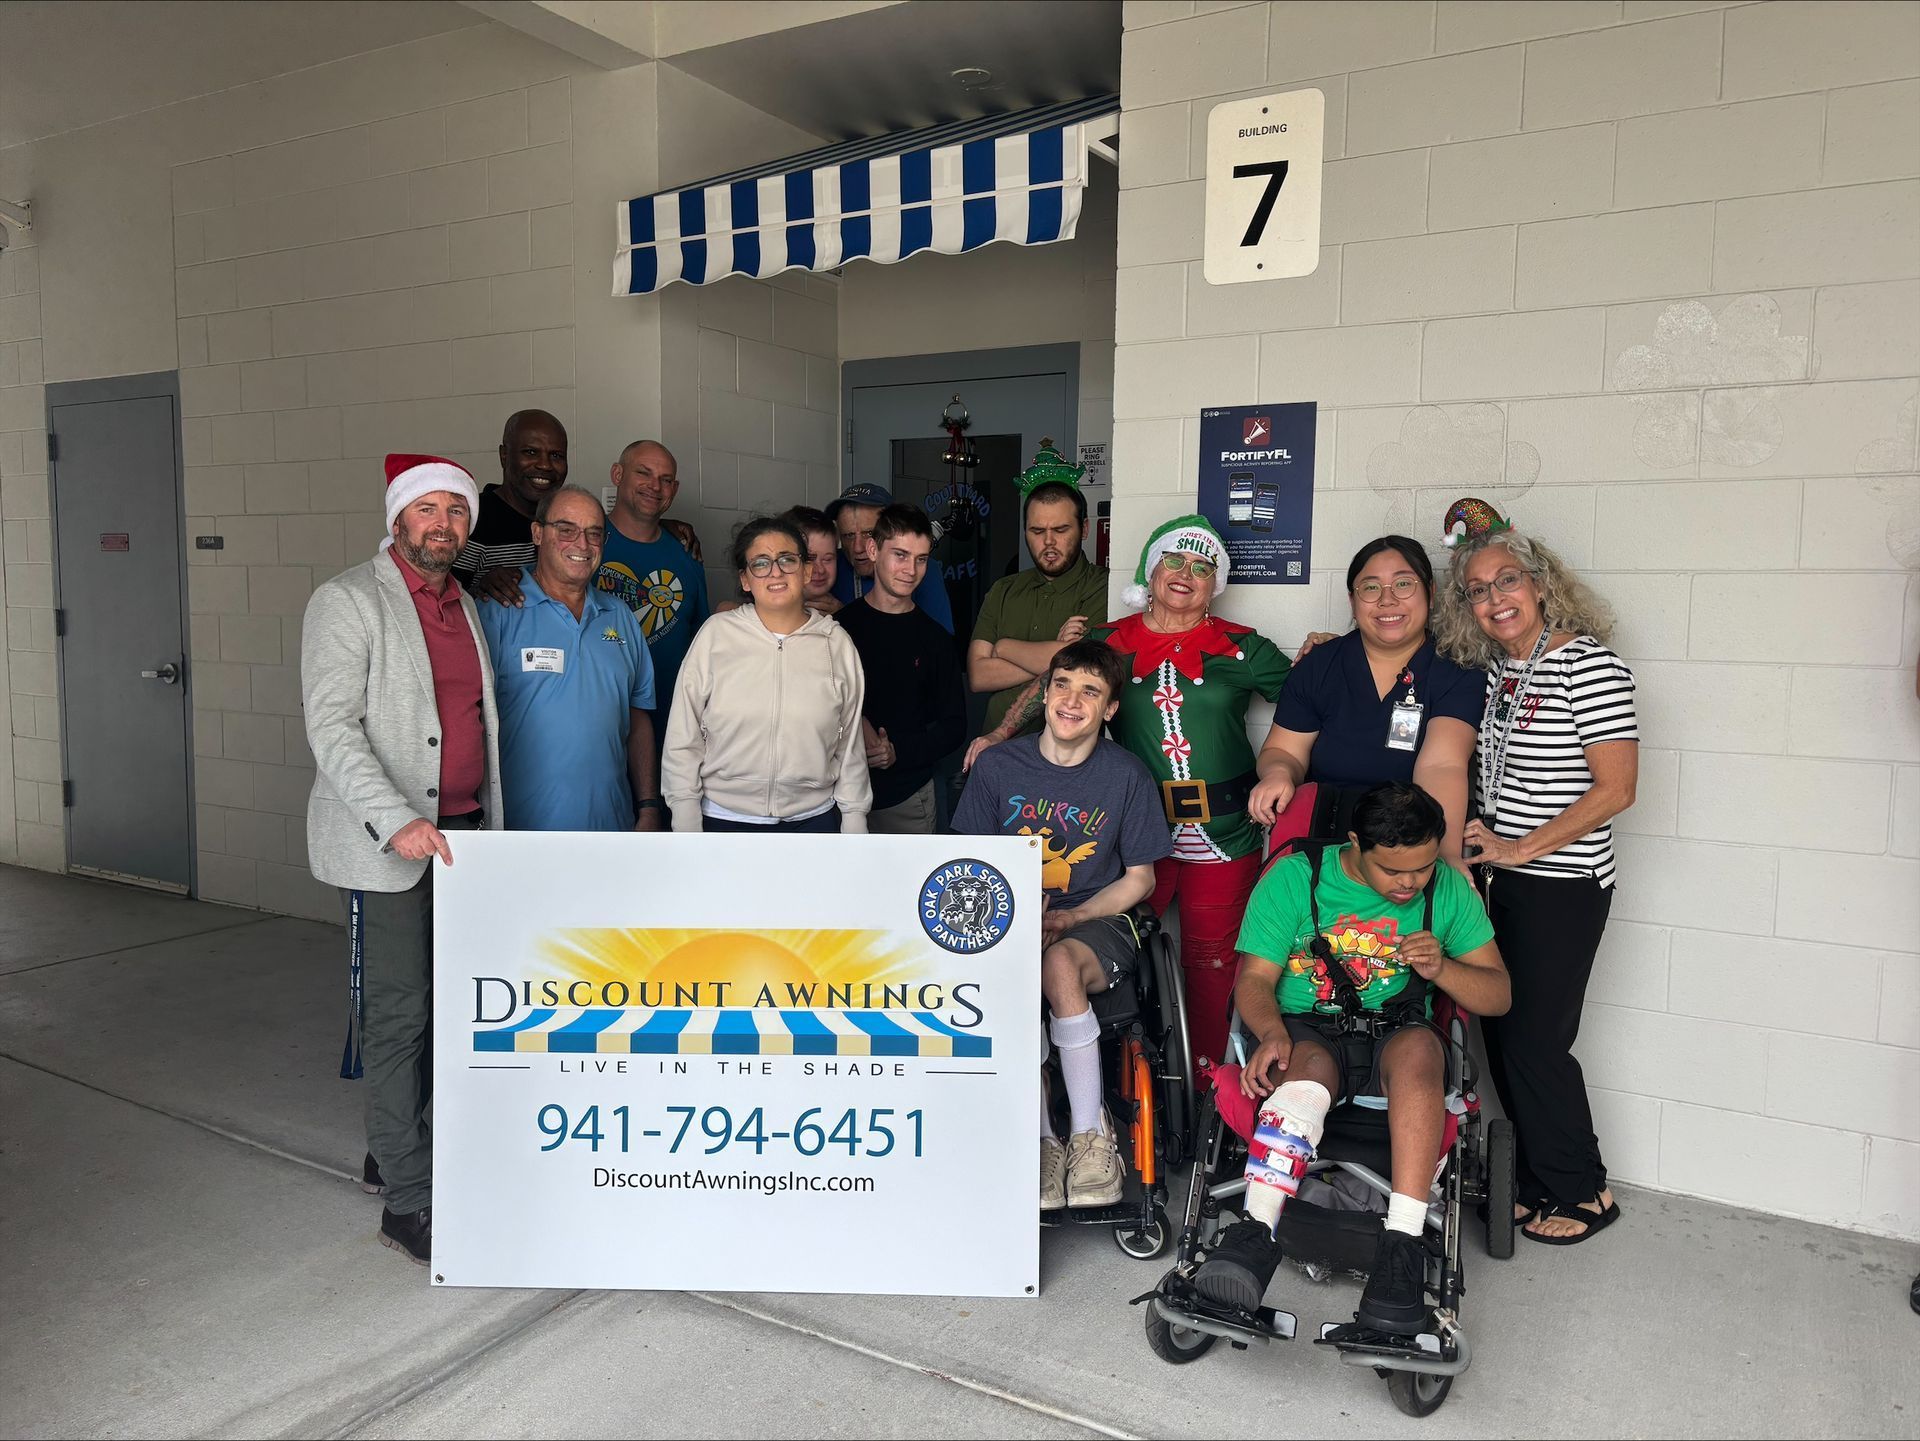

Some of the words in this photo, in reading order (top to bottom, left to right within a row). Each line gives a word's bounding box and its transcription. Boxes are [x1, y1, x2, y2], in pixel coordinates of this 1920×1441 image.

[1238, 123, 1288, 138] BUILDING
[1232, 159, 1289, 247] 7
[1080, 446, 1104, 454] PLEASE
[1176, 537, 1212, 558] SMILE
[924, 888, 939, 919] OAK
[935, 864, 973, 886] PARK
[979, 868, 1009, 919] SCHOOL
[931, 923, 1000, 949] PANTHERS
[560, 1060, 628, 1074] LIVE
[660, 1061, 688, 1075] IN
[717, 1061, 773, 1075] THE
[804, 1062, 906, 1077] SHADE
[537, 1103, 924, 1158] 941-794-6451
[593, 1167, 875, 1195] DiscountAwningsInc.com
